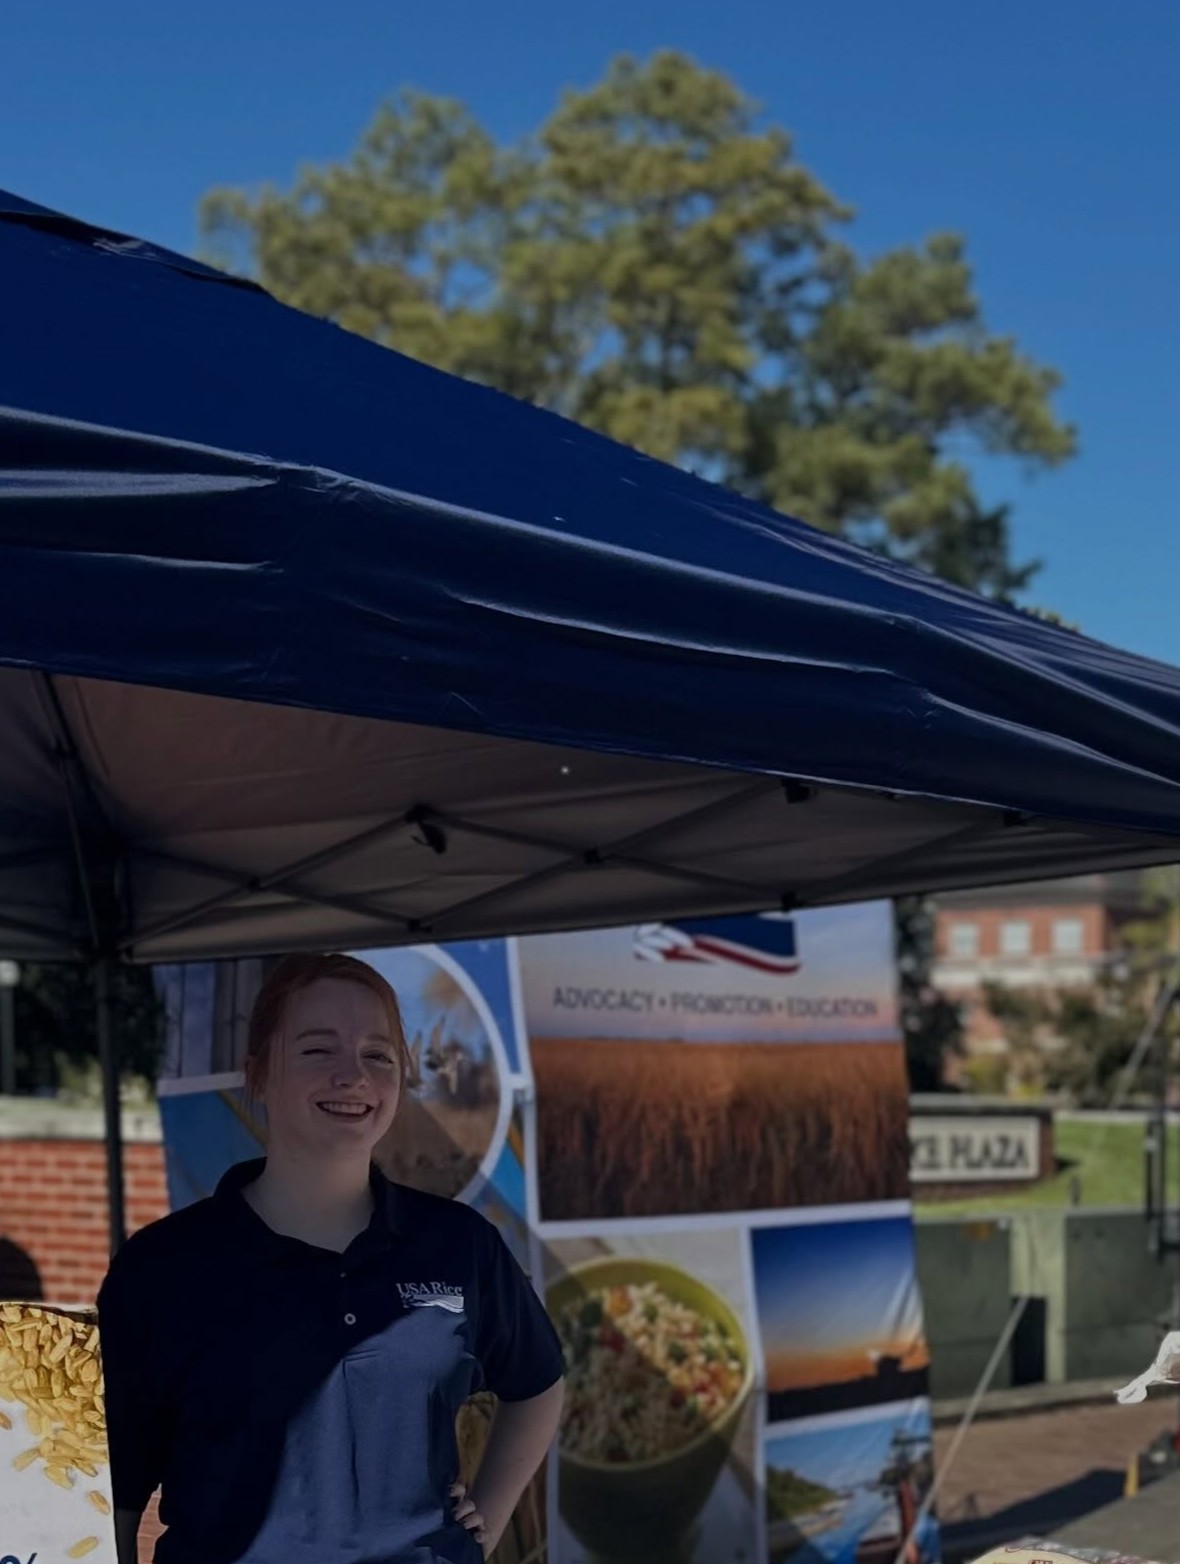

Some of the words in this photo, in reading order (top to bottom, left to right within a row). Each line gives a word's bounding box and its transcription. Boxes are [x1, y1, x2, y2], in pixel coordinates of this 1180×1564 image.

[553, 987, 653, 1011] ADVOCACY
[671, 992, 773, 1016] PROMOTION
[786, 994, 878, 1018] EDUCATION
[950, 1133, 1030, 1169] PLAZA
